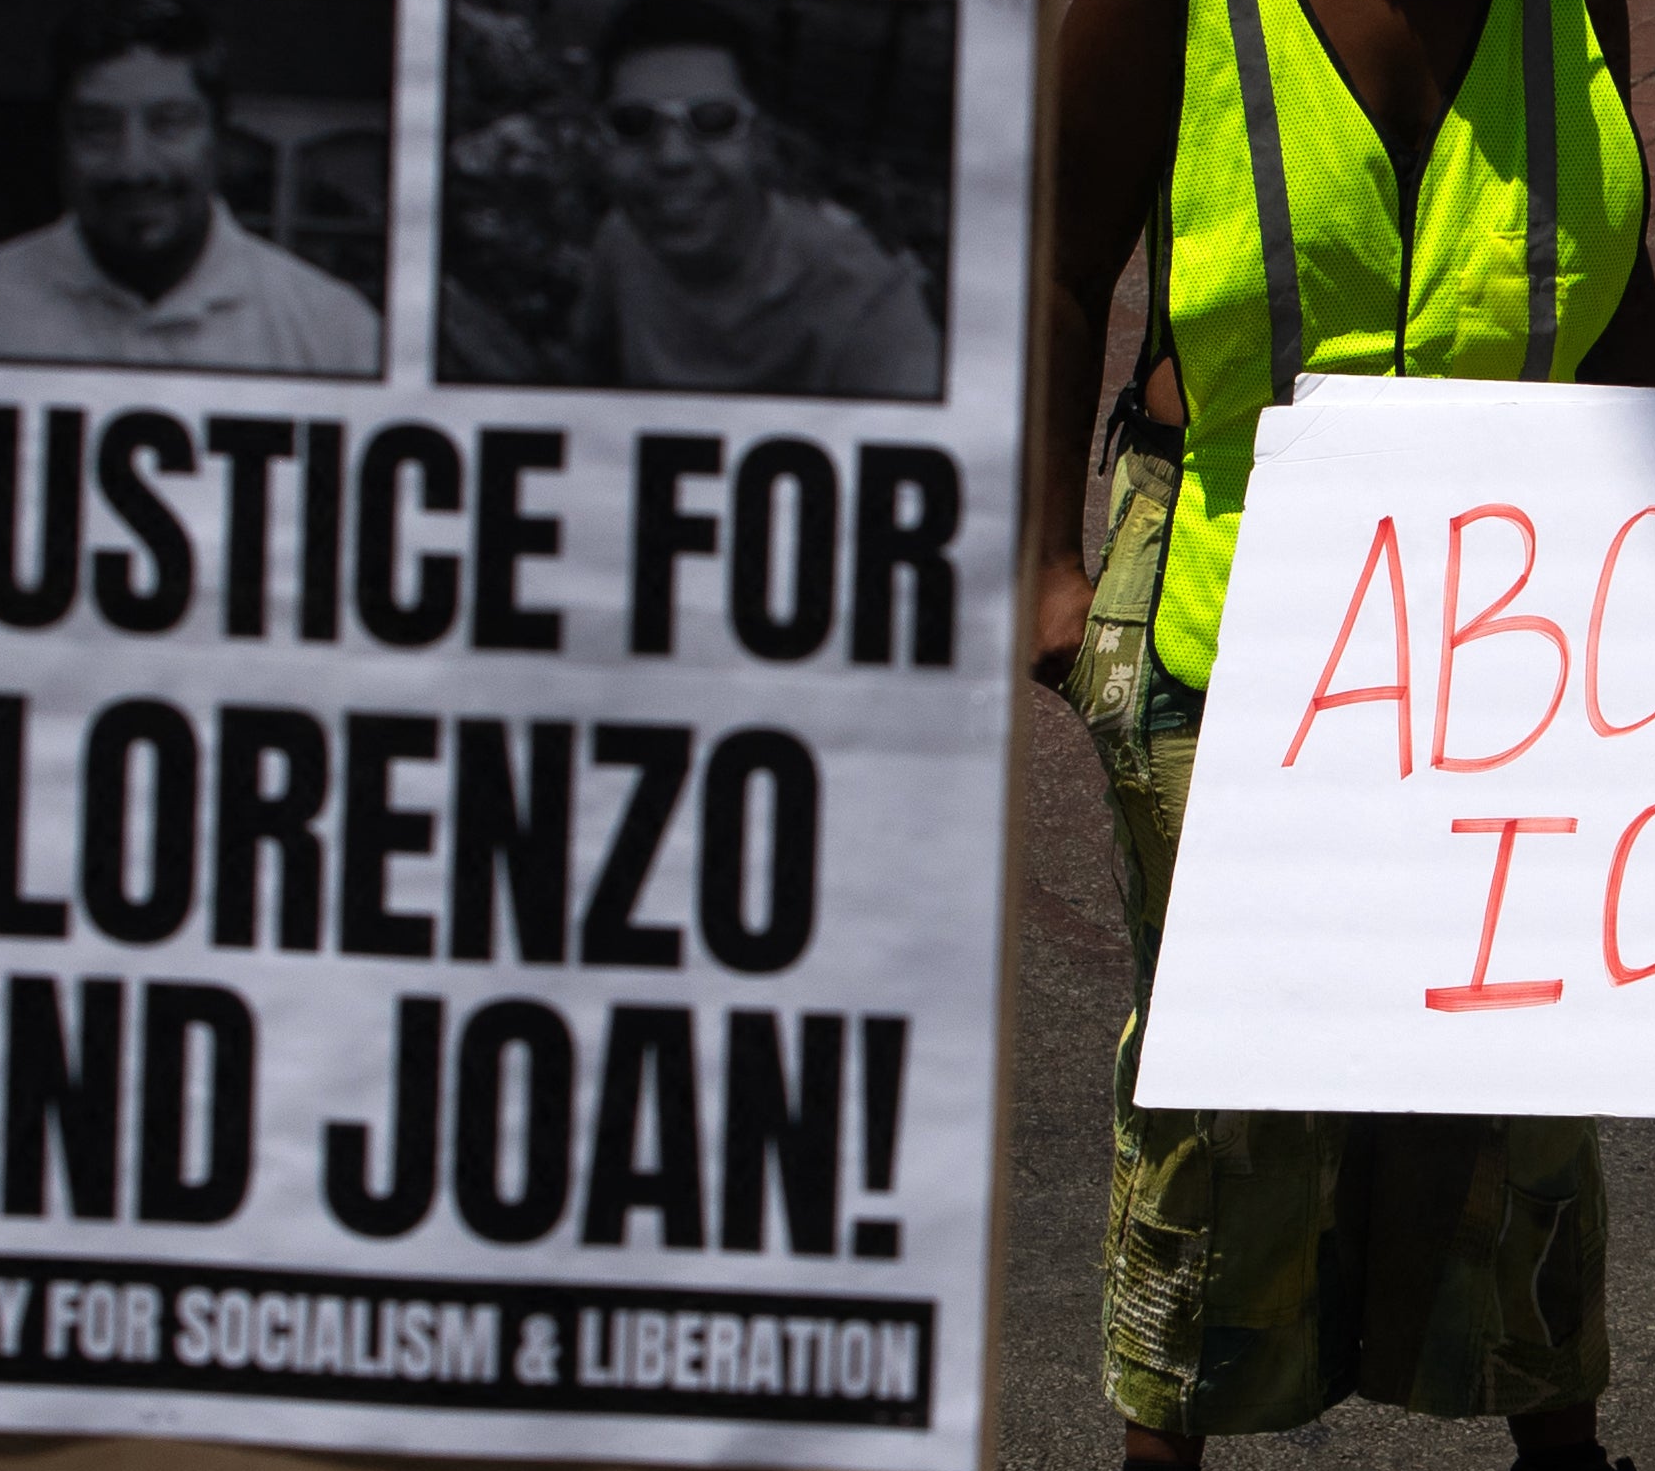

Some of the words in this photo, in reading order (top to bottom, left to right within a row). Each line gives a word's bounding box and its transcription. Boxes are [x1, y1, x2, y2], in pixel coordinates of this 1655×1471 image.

[624, 432, 965, 670] FOR
[322, 996, 909, 1258] JOAN!
[46, 1281, 160, 1360] FOR
[177, 1286, 498, 1386] SOCIALISM
[516, 1314, 558, 1386] &
[579, 1310, 918, 1403] LIBERATION
